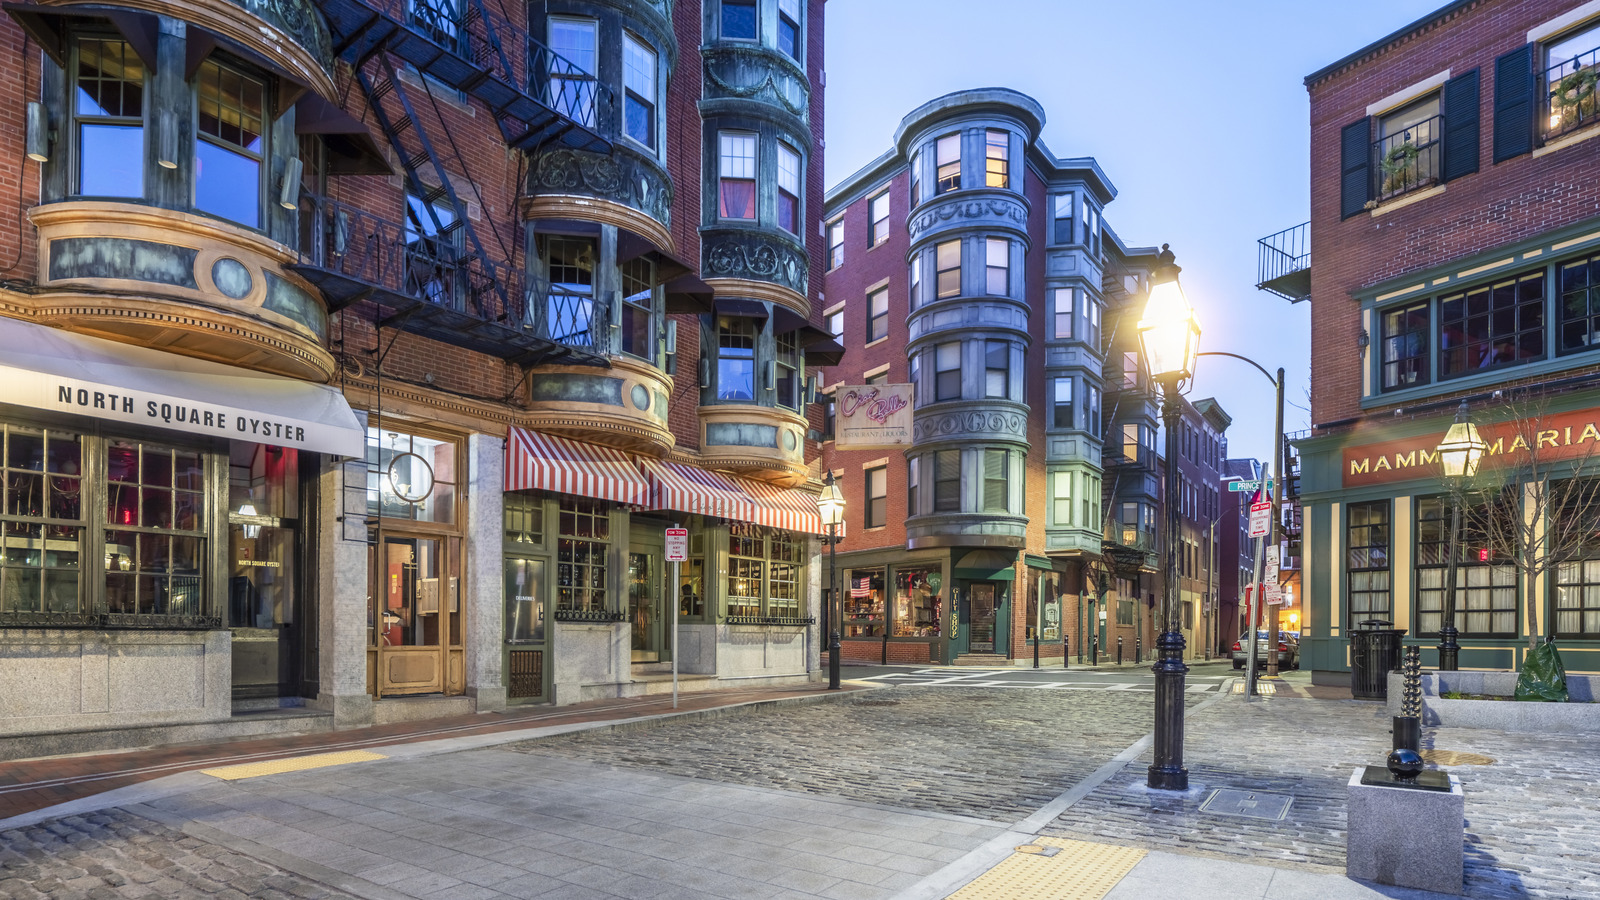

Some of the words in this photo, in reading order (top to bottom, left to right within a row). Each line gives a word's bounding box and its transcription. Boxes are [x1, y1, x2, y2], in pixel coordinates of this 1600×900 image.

[58, 385, 134, 414] NORTH
[147, 400, 226, 429] SQUARE
[236, 416, 305, 442] OYSTER
[841, 390, 879, 417] Ciao
[866, 394, 908, 425] Bella
[1350, 448, 1440, 476] MAMM
[1481, 423, 1600, 457] MARIA
[1237, 482, 1261, 490] PRINCE
